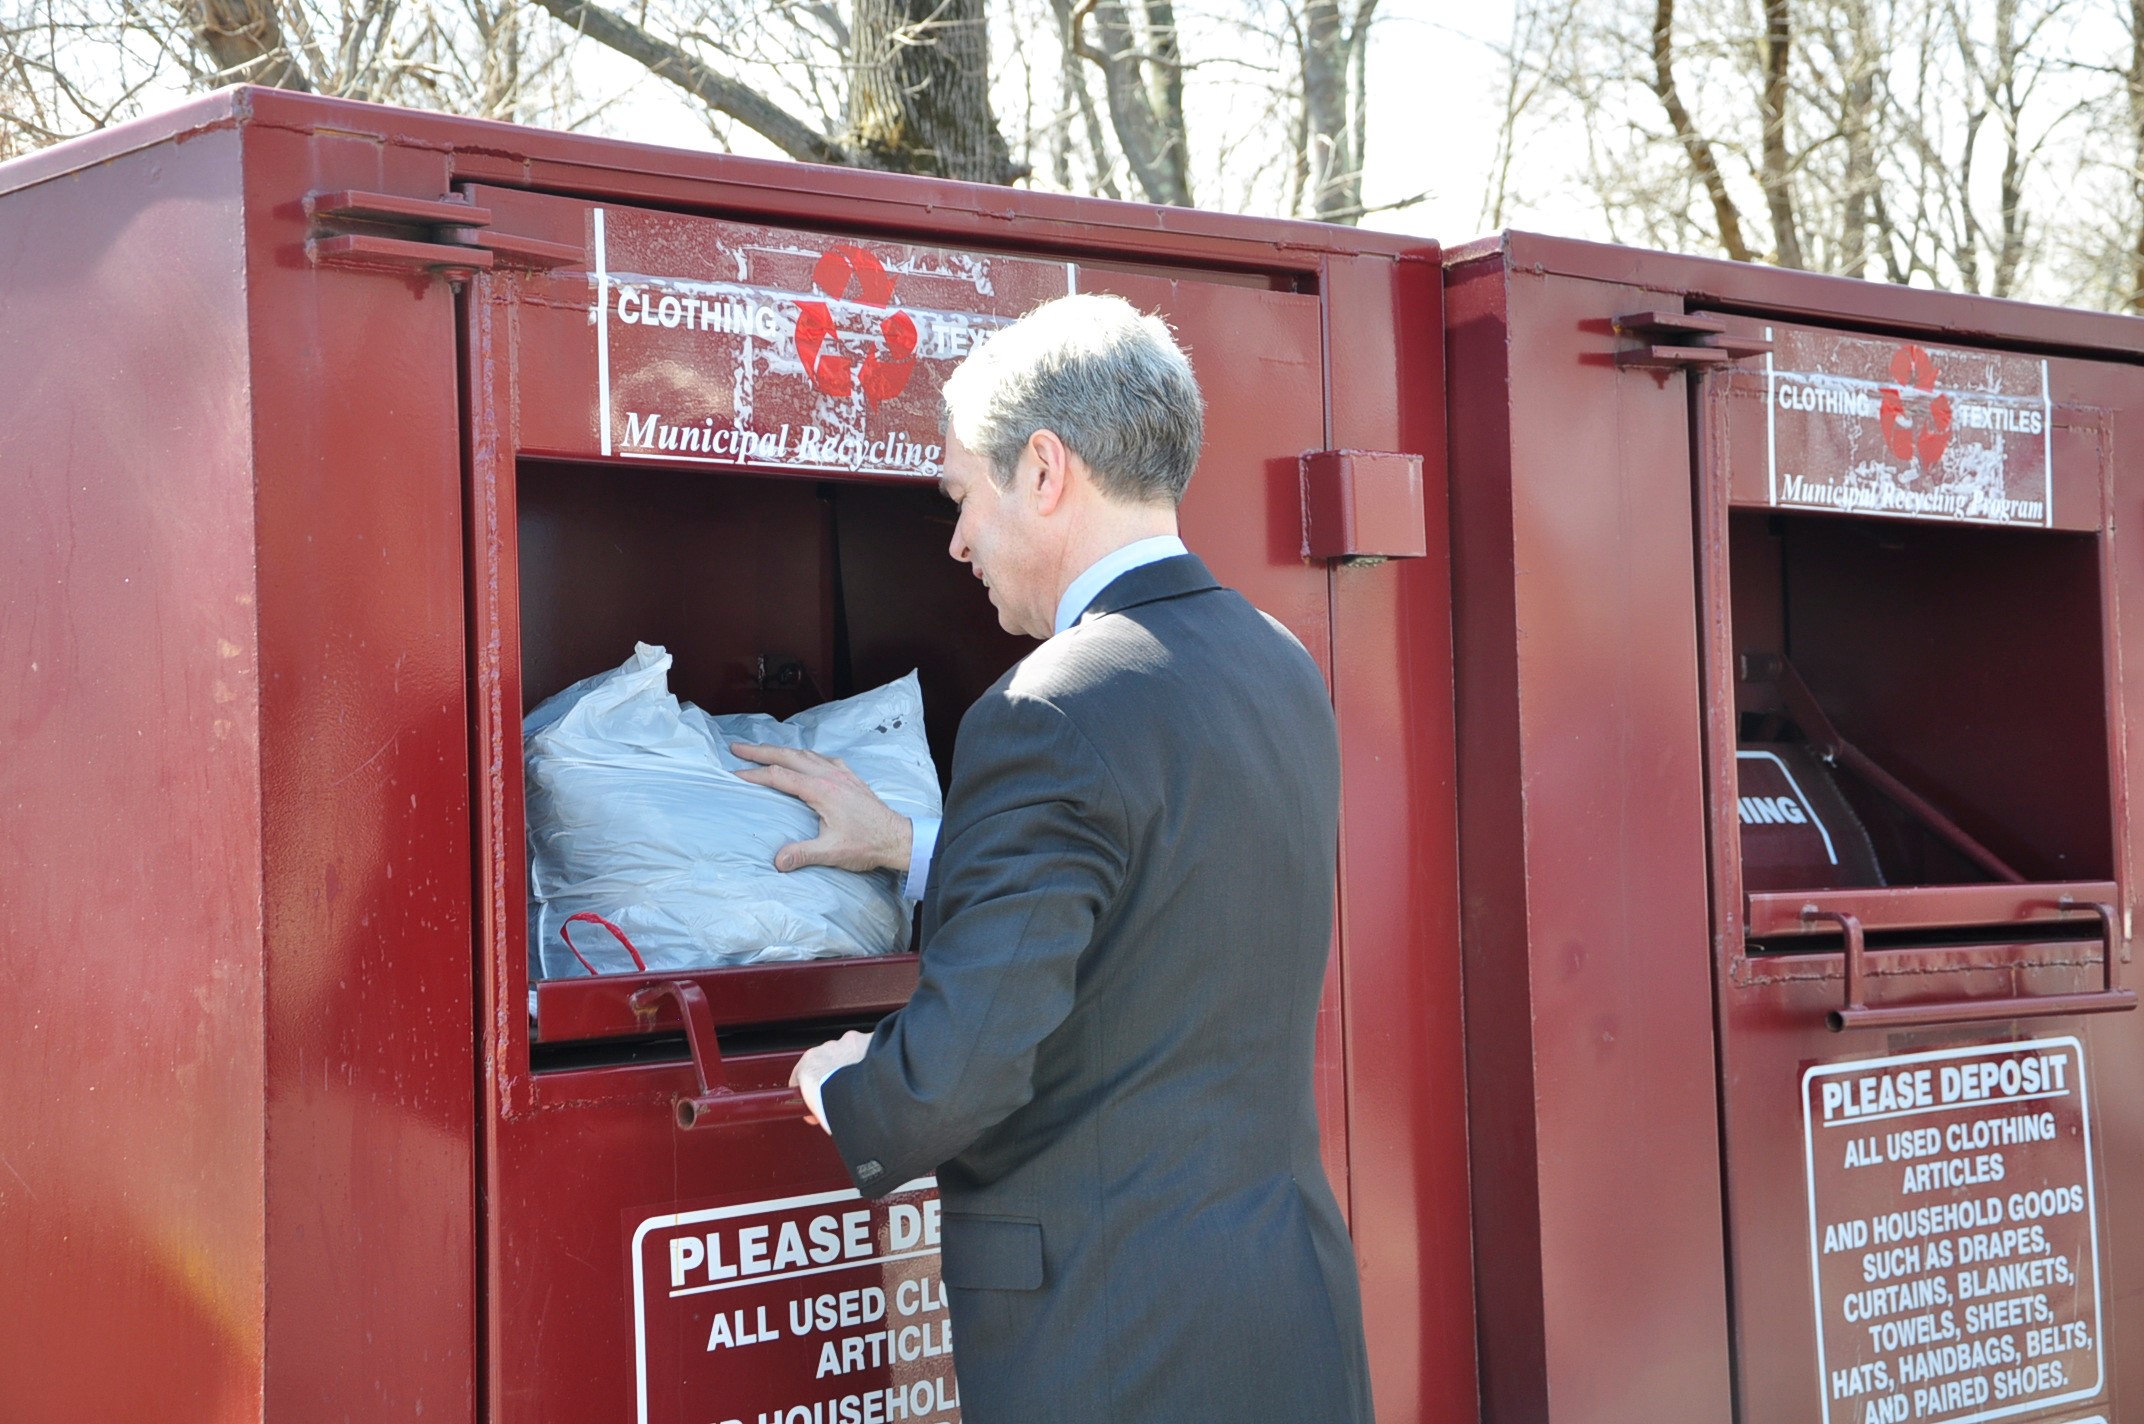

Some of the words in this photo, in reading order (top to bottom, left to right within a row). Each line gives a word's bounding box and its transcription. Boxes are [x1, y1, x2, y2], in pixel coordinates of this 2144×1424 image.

[617, 293, 776, 338] CLOTHING
[931, 323, 998, 357] TEX
[1778, 384, 1871, 417] CLOTHING
[1959, 404, 2042, 435] TEXTILES
[622, 412, 787, 464] Municipal
[799, 425, 942, 476] Recycling
[1781, 474, 1877, 511] Municipal
[1880, 482, 1966, 520] Recycling
[1966, 489, 2043, 524] Program
[1822, 1069, 1933, 1119] PLEASE
[1940, 1054, 2068, 1103] DEPOSIT
[1844, 1136, 1883, 1169] ALL
[1887, 1126, 1941, 1162] USED
[1946, 1112, 2056, 1149] CLOTHING
[1902, 1153, 2005, 1195] ARTICLES
[669, 1209, 873, 1287] PLEASE
[1824, 1219, 1867, 1254] AND
[1873, 1197, 2003, 1244] HOUSEHOLD
[2008, 1184, 2085, 1221] GOODS
[1862, 1248, 1921, 1282] SUCH
[1925, 1239, 1954, 1271] AS
[1958, 1226, 2052, 1266] DRAPES,
[707, 1305, 780, 1352] ALL
[789, 1286, 886, 1336] USED
[1843, 1276, 1954, 1323] CURTAINS,
[1958, 1256, 2075, 1300] BLANKETS,
[1868, 1310, 1961, 1353] TOWELS,
[1965, 1293, 2054, 1334] SHEETS,
[1832, 1360, 1895, 1400] HATS,
[1898, 1334, 2022, 1385] HANDBAGS,
[2026, 1320, 2093, 1359] BELTS,
[1864, 1394, 1909, 1424] AND
[1915, 1375, 1989, 1418] PAIRED
[1994, 1360, 2068, 1400] SHOES.
